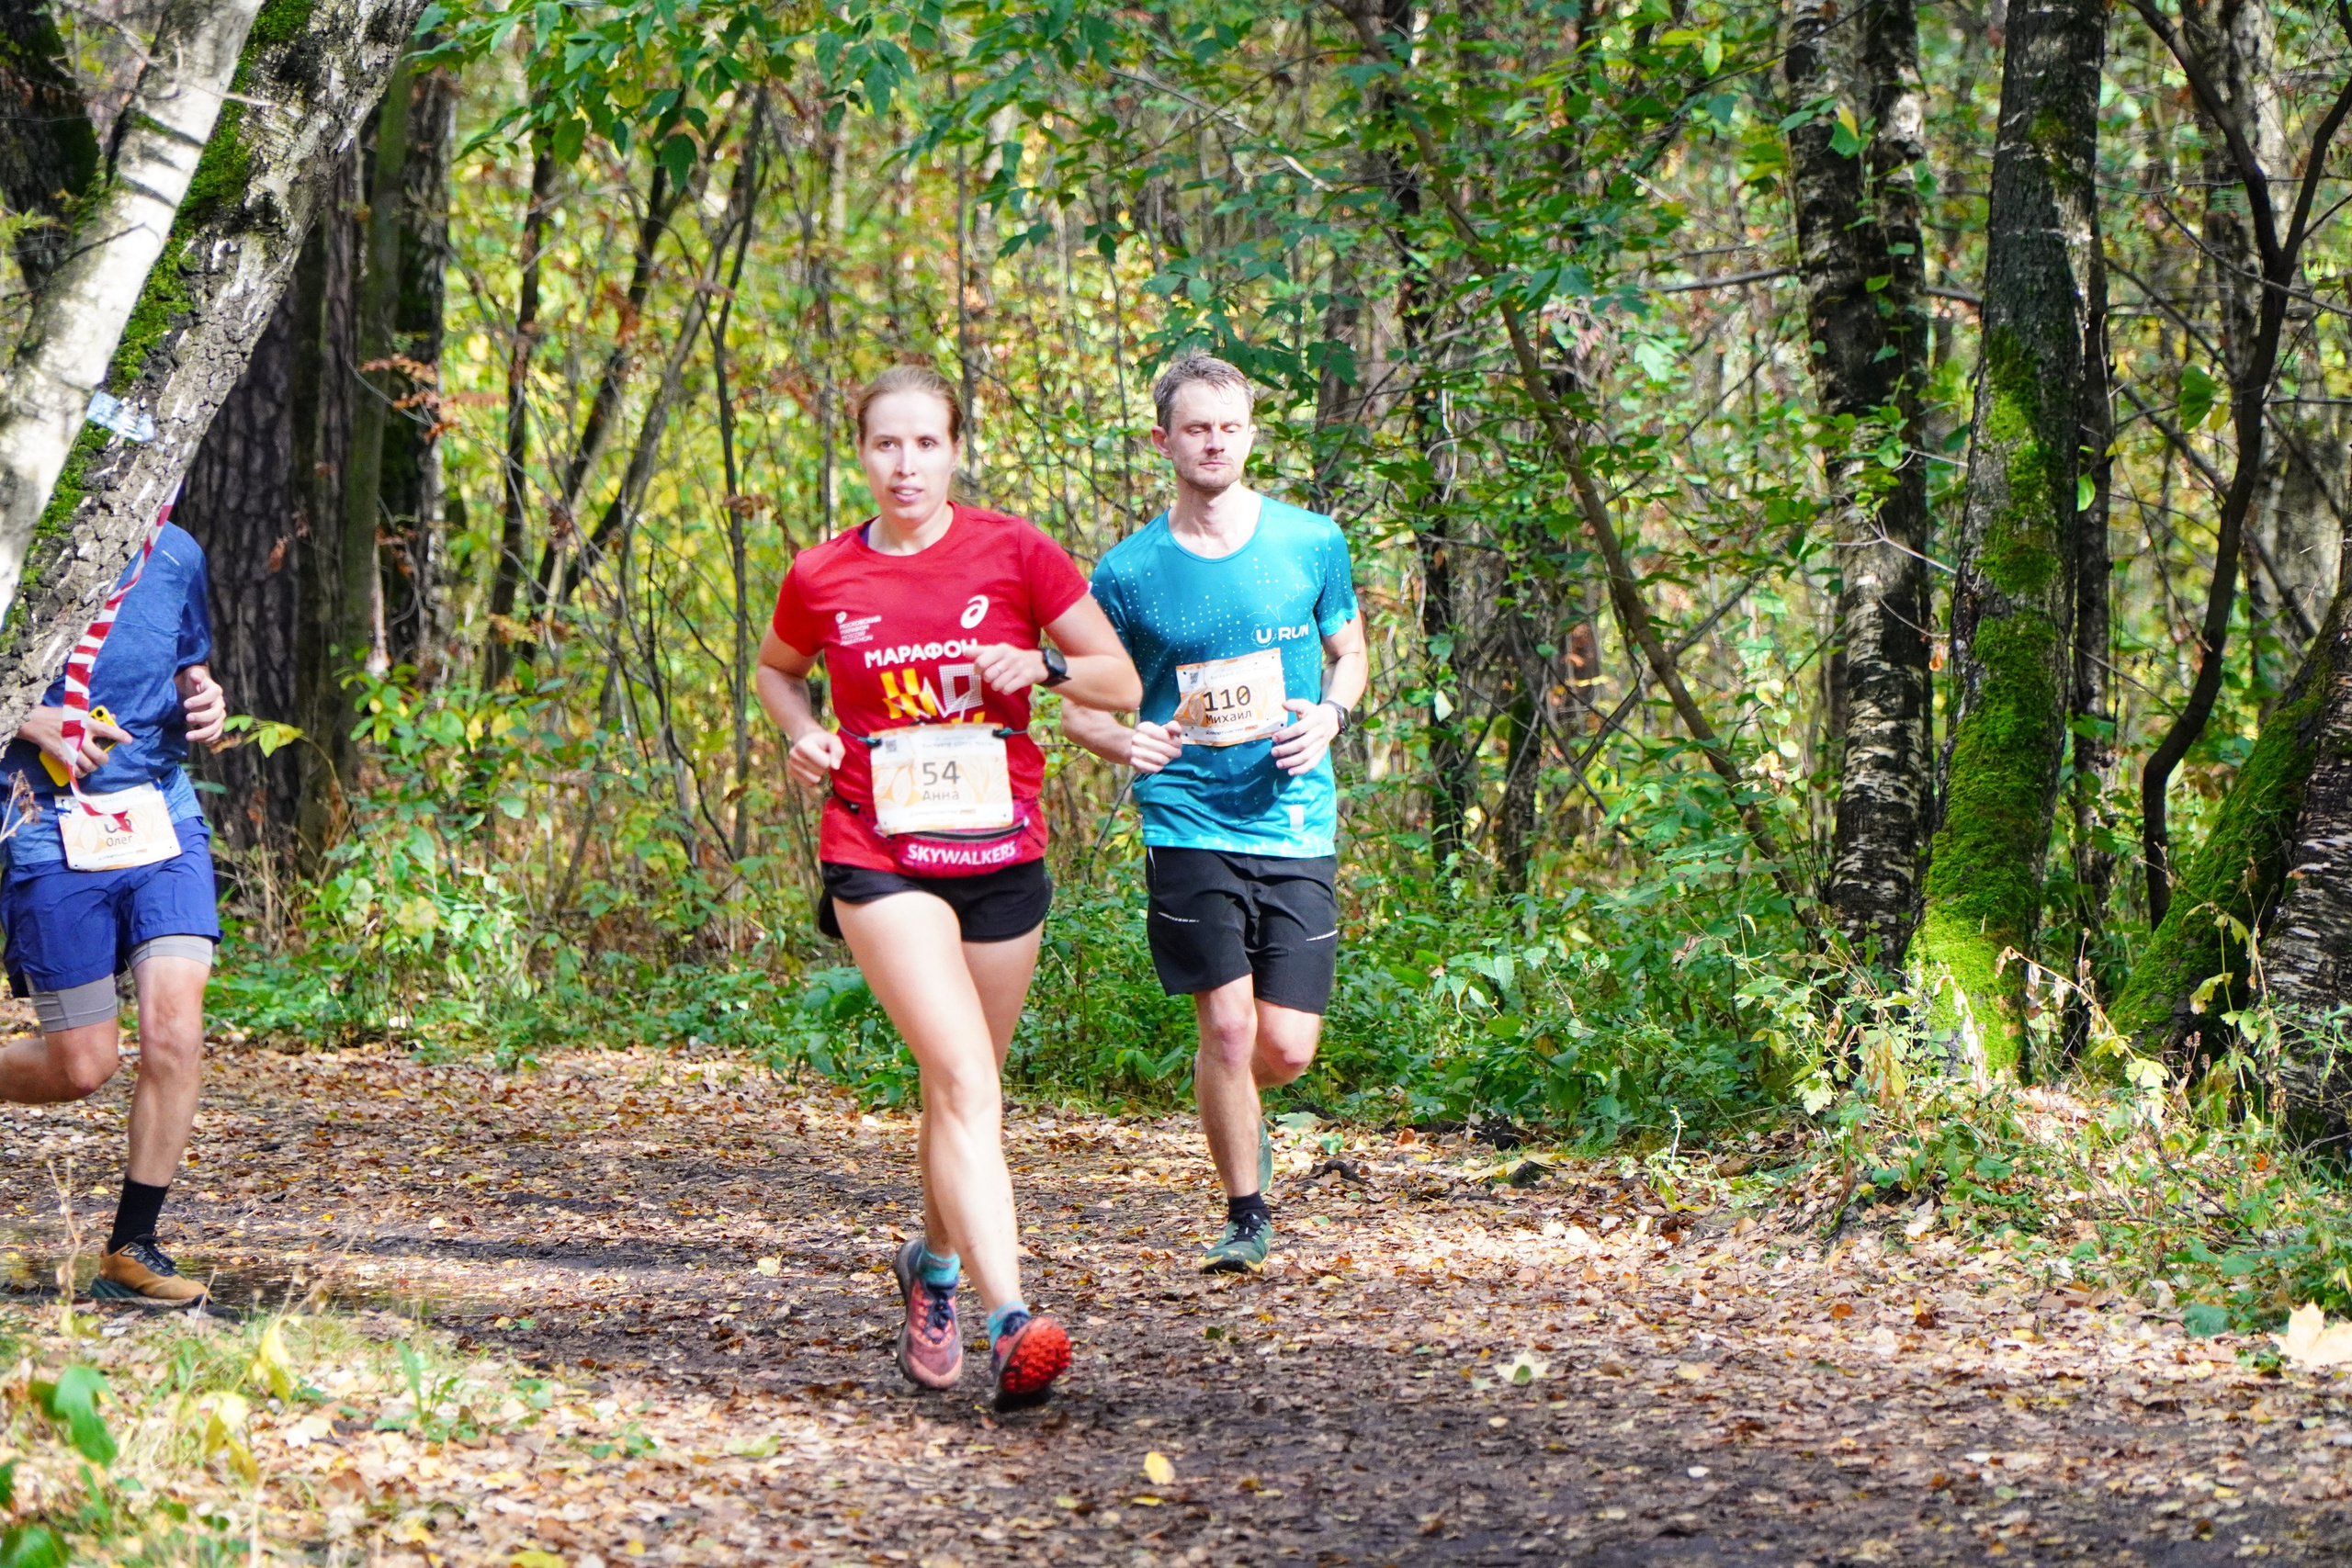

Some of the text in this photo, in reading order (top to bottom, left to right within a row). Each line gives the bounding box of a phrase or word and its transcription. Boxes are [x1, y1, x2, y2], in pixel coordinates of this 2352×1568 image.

[1278, 623, 1308, 641] RUN
[1203, 685, 1251, 712] 110
[1205, 710, 1252, 724] Михаил
[922, 761, 960, 785] 54
[922, 789, 960, 801] Анна
[106, 835, 132, 847] Олег
[907, 841, 1016, 865] SKYWALKERS
